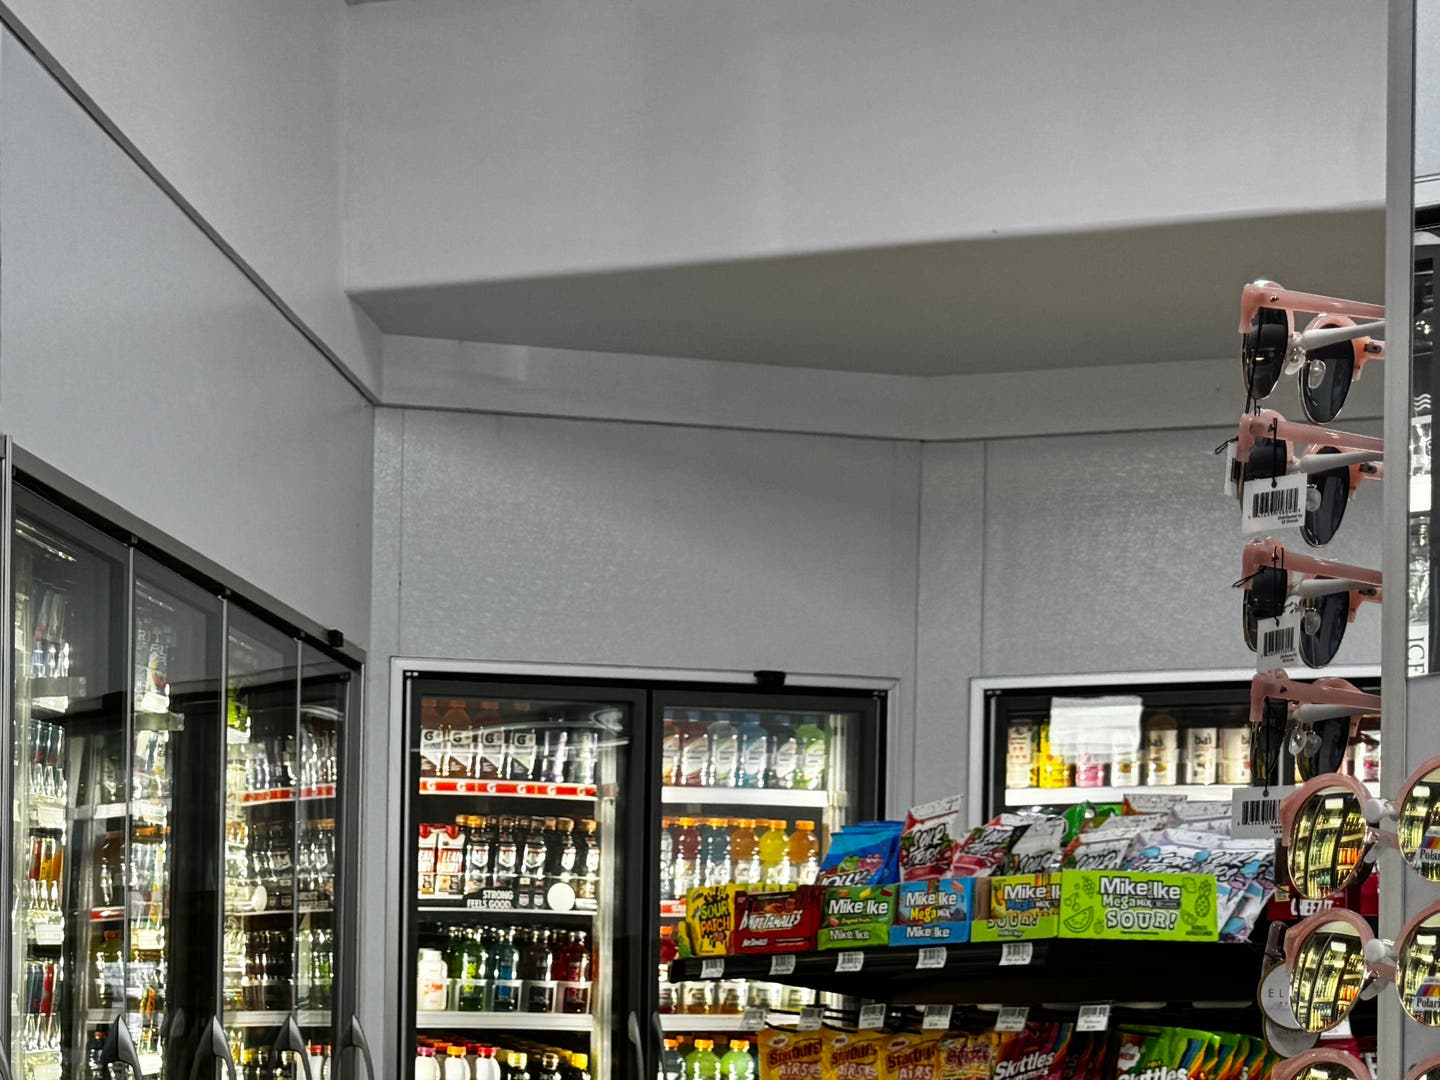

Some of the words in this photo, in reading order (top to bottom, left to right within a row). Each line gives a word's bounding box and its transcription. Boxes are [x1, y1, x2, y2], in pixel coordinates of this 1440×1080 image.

[424, 730, 434, 741] G
[453, 734, 463, 743] G
[485, 733, 495, 744] G
[516, 734, 526, 745] G
[913, 825, 947, 850] SOUR
[483, 889, 514, 900] STRONG
[1004, 884, 1047, 900] Mike
[1100, 877, 1149, 897] Mike
[1152, 880, 1182, 901] Ike
[466, 900, 488, 909] FEELS
[906, 892, 935, 907] Mike
[938, 891, 957, 907] Ike
[1103, 895, 1137, 909] Mega
[700, 901, 729, 919] SOUR
[829, 899, 863, 915] Mike
[866, 899, 889, 915] Ike
[910, 906, 937, 923] Mega
[700, 916, 730, 933] PATCH
[1106, 909, 1179, 931] SOUR!
[830, 929, 853, 941] Mike
[855, 929, 870, 940] Ike
[906, 925, 932, 939] Mike
[934, 925, 950, 939] Ike
